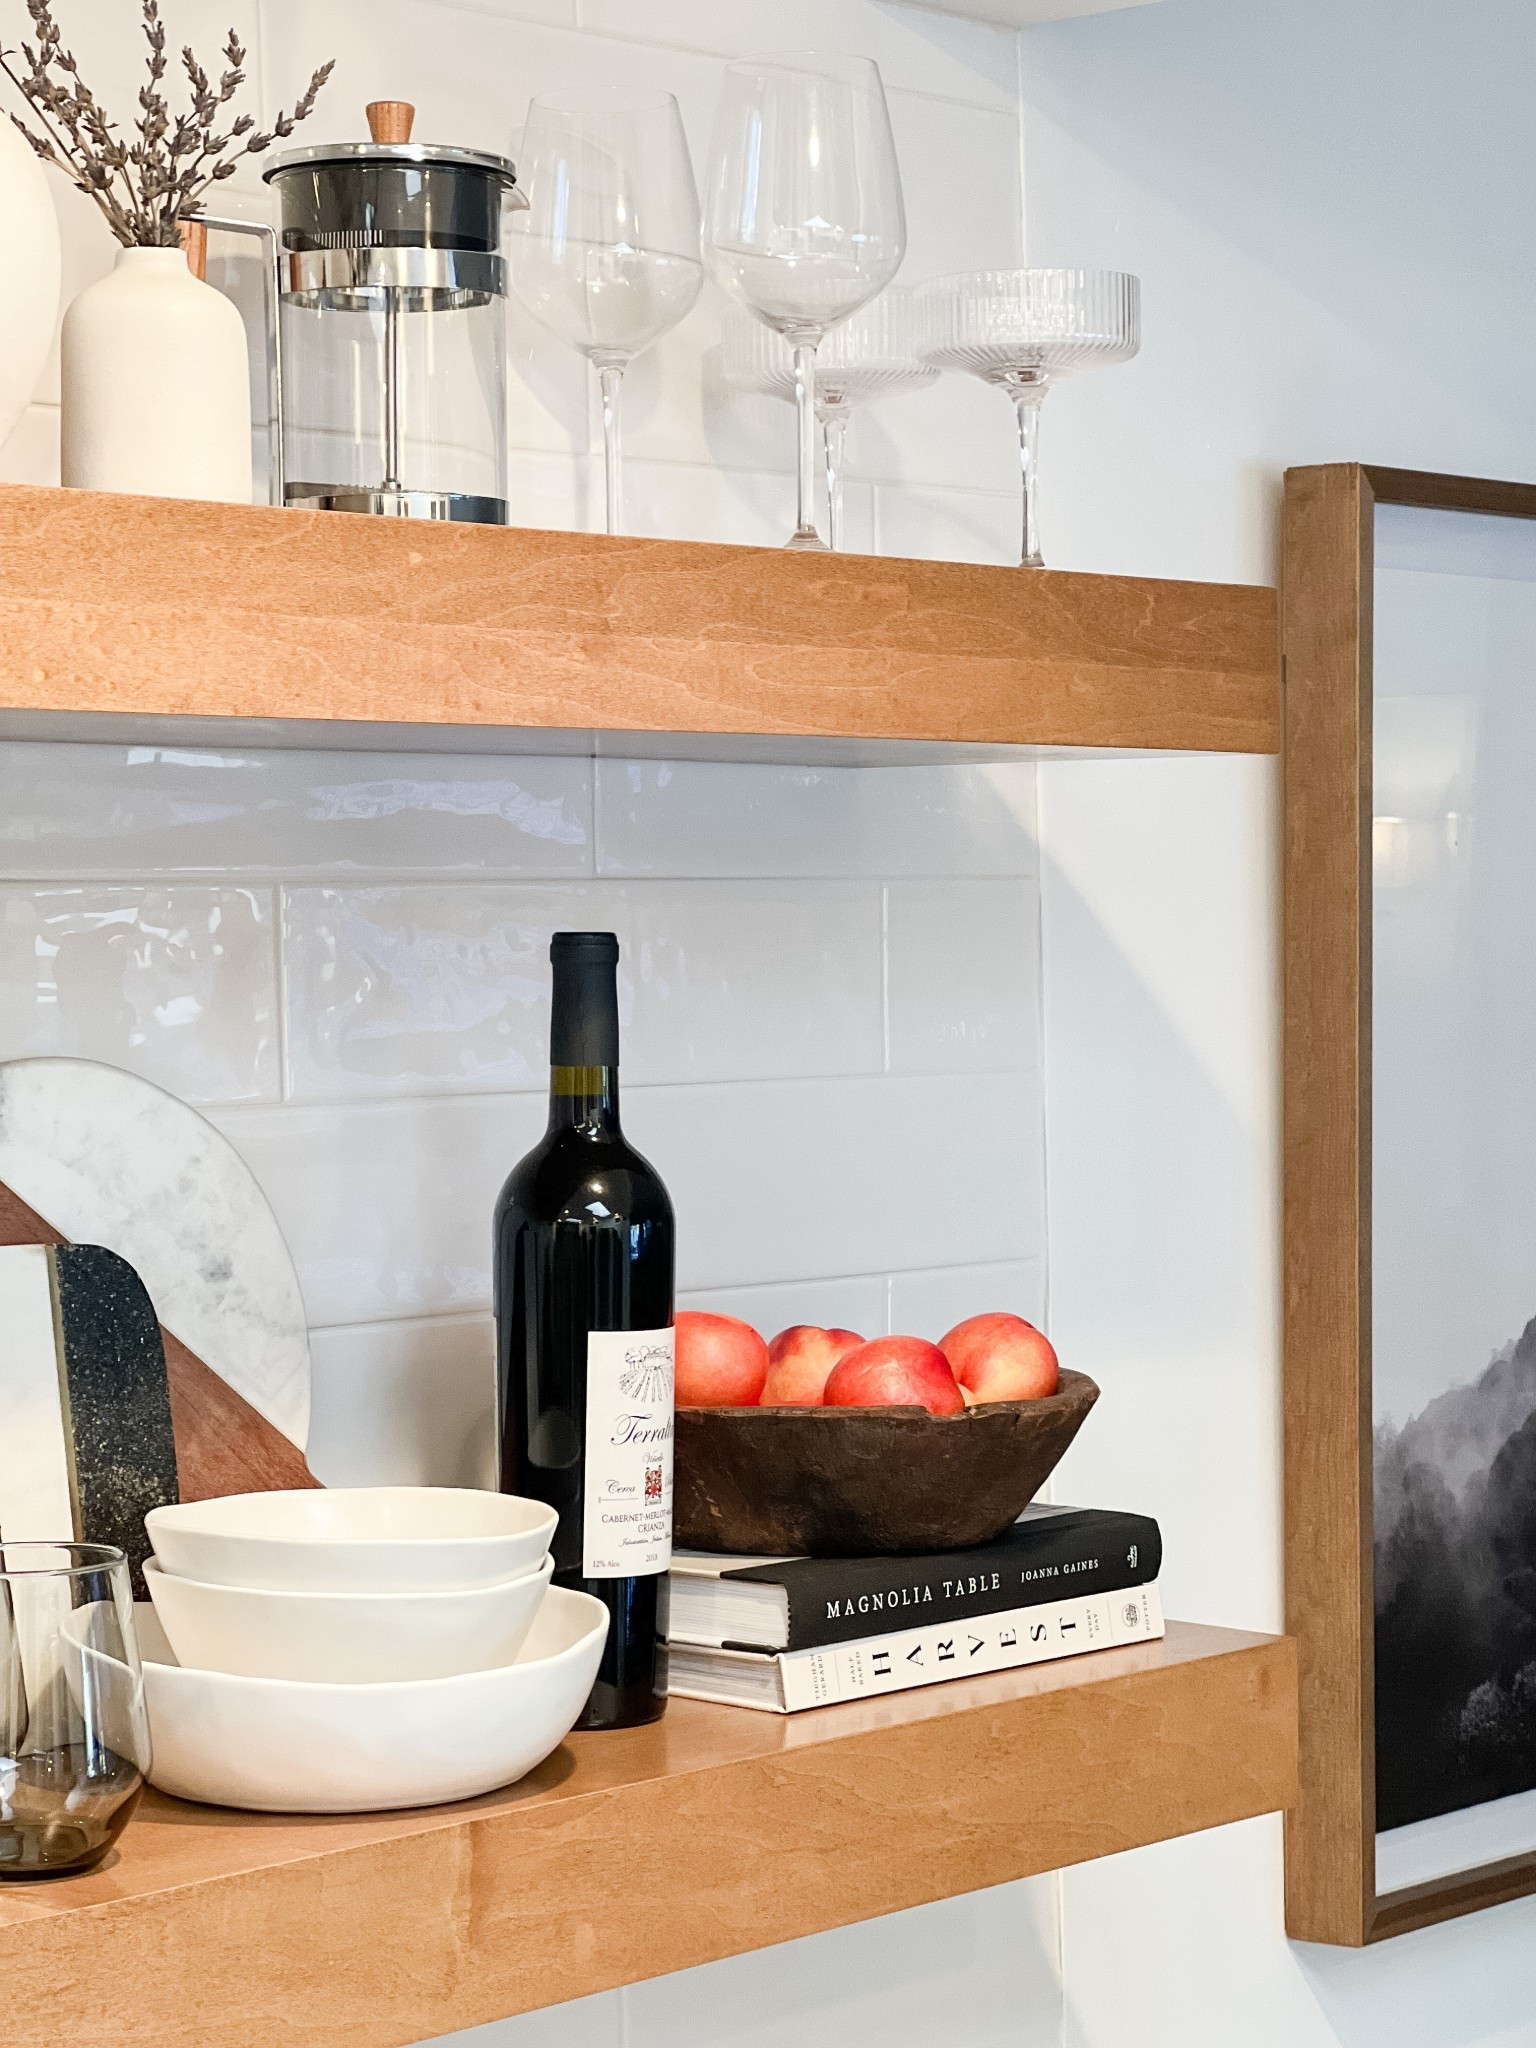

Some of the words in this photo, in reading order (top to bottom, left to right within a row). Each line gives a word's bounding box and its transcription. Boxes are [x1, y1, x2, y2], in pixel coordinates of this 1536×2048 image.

[1020, 1565, 1060, 1584] JOANNA
[1063, 1558, 1099, 1575] GAINES
[826, 1585, 933, 1619] MAGNOLIA
[943, 1572, 1001, 1599] TABLE
[871, 1616, 1077, 1677] HARVEST
